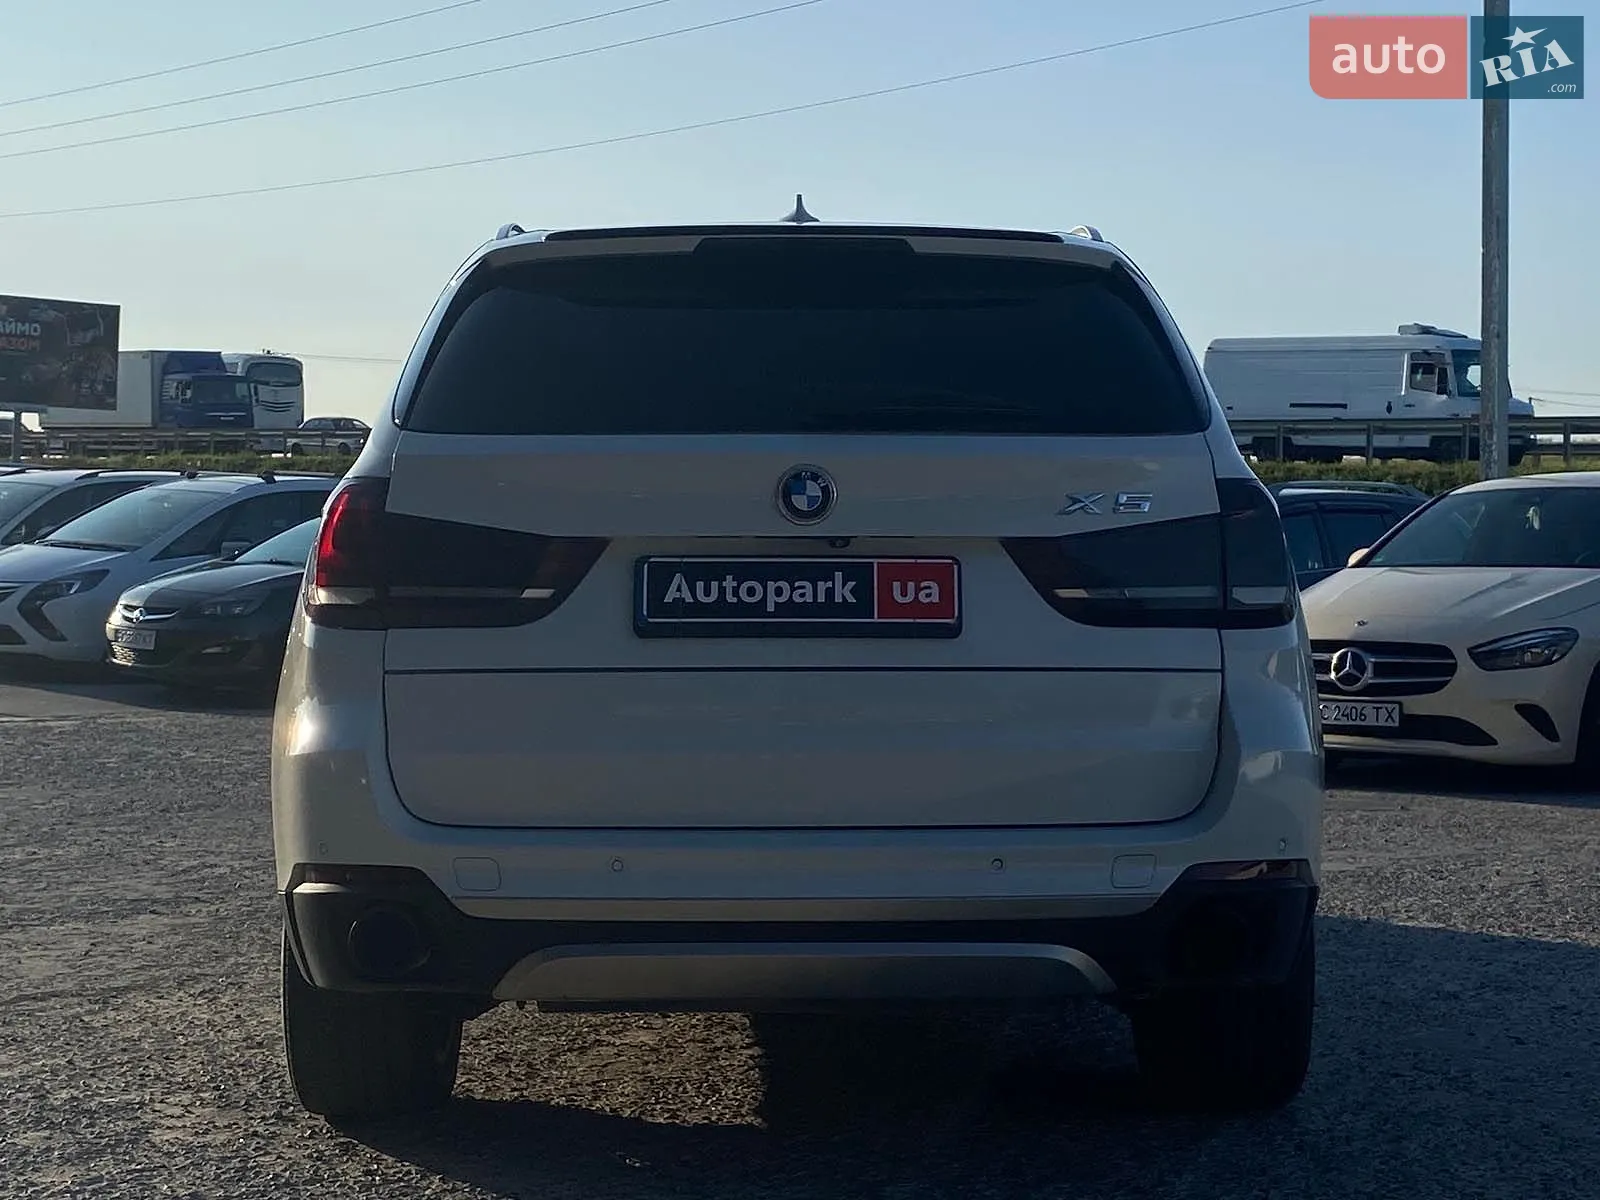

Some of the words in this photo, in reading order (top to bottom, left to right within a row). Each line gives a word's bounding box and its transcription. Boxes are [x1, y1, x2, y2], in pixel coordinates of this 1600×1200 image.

[663, 571, 857, 612] Autopark
[891, 580, 941, 604] ua
[1332, 705, 1367, 722] 2406
[1372, 706, 1396, 723] TX
